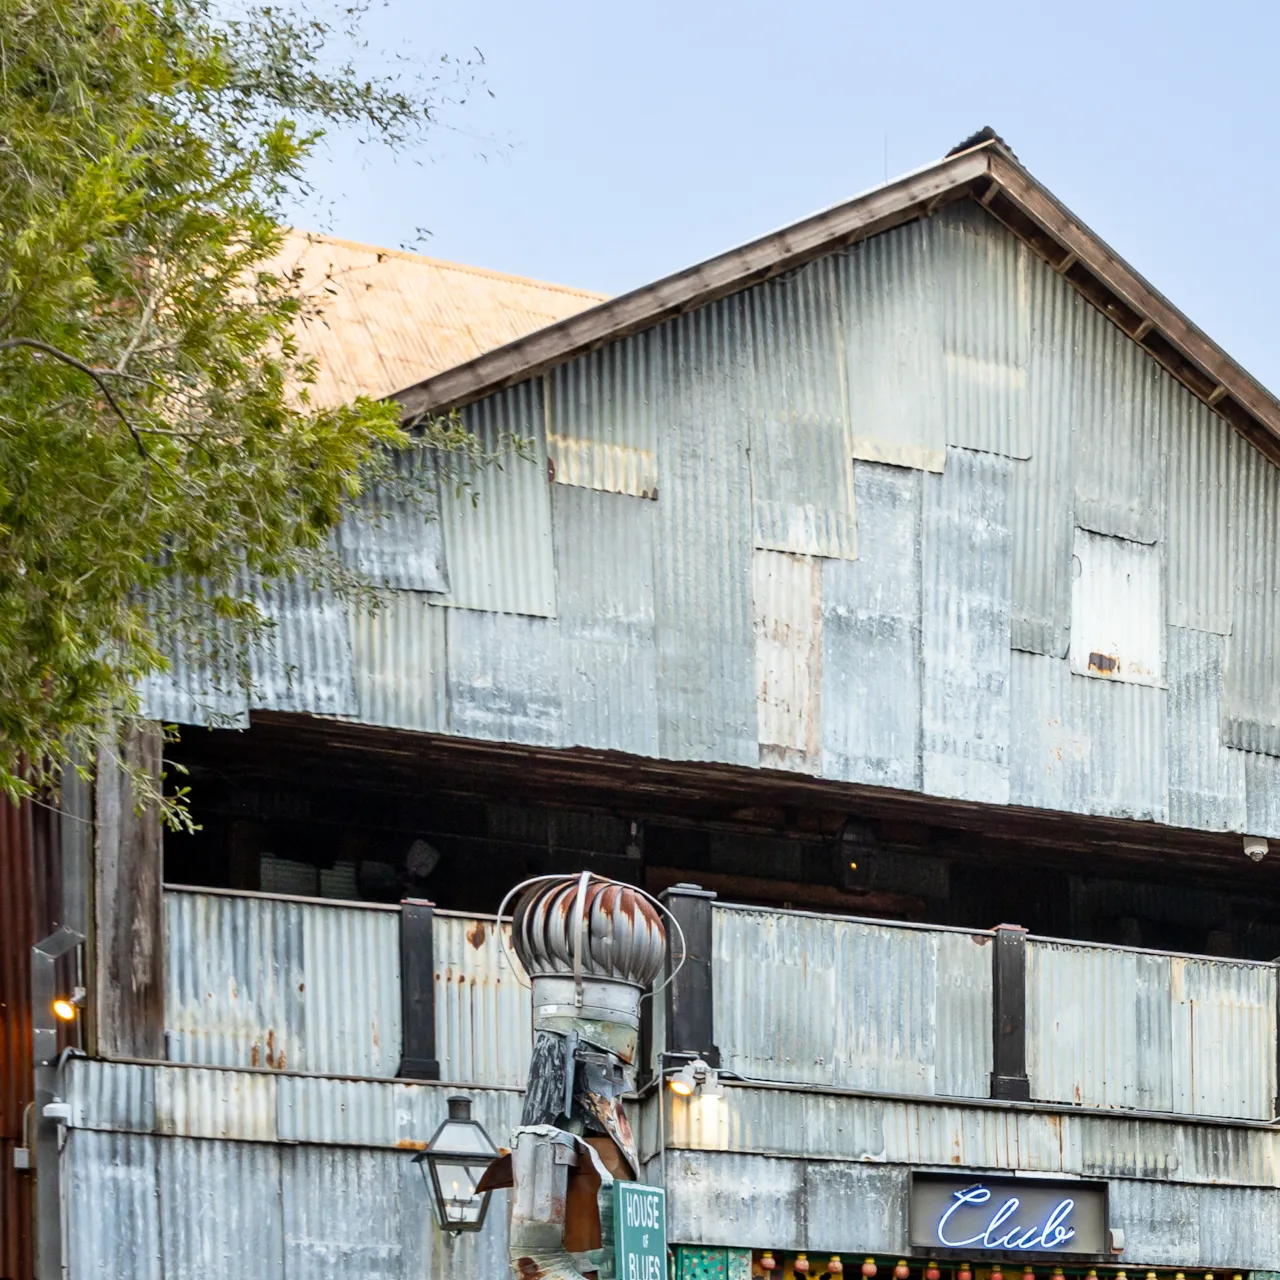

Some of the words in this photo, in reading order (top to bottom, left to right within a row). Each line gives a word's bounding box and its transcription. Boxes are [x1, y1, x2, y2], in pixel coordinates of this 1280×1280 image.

[626, 1192, 660, 1230] HOUSE
[937, 1188, 1076, 1249] Club
[642, 1234, 649, 1249] OF
